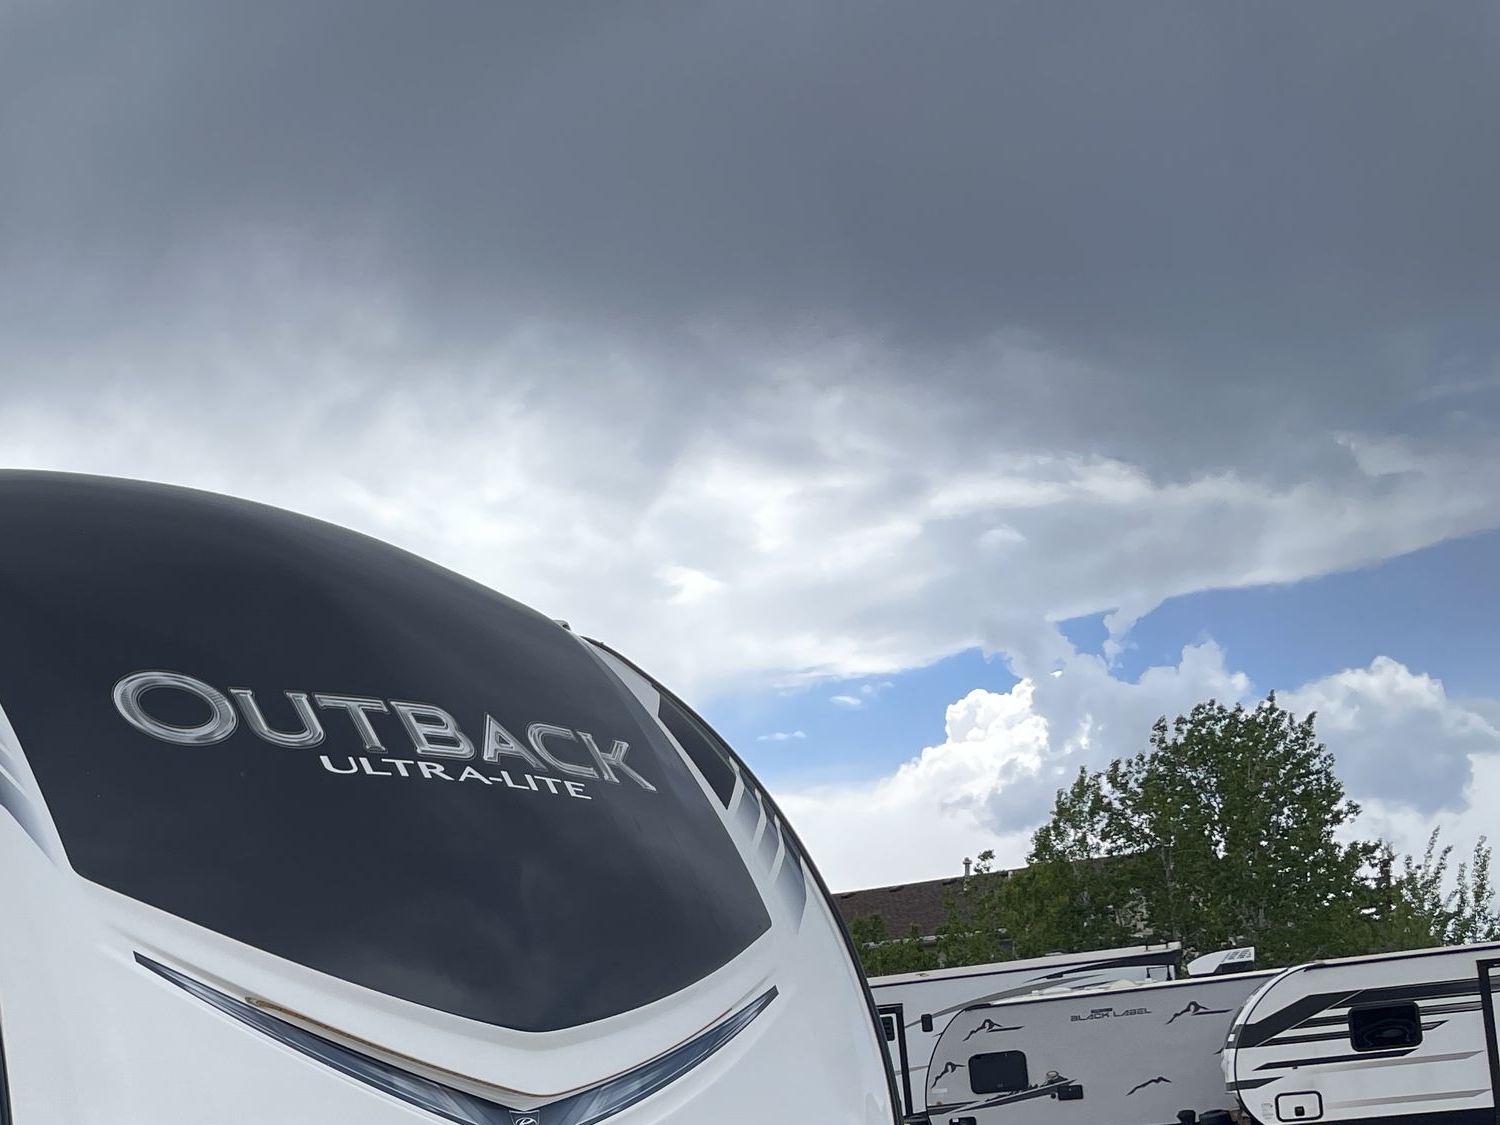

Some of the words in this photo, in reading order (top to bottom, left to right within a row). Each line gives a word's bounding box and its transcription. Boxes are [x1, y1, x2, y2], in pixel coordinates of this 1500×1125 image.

[112, 670, 657, 792] OUTBACK
[319, 754, 592, 800] ULTRA-LITE
[1070, 1011, 1110, 1021] BLACK
[1113, 1007, 1152, 1017] LABEL
